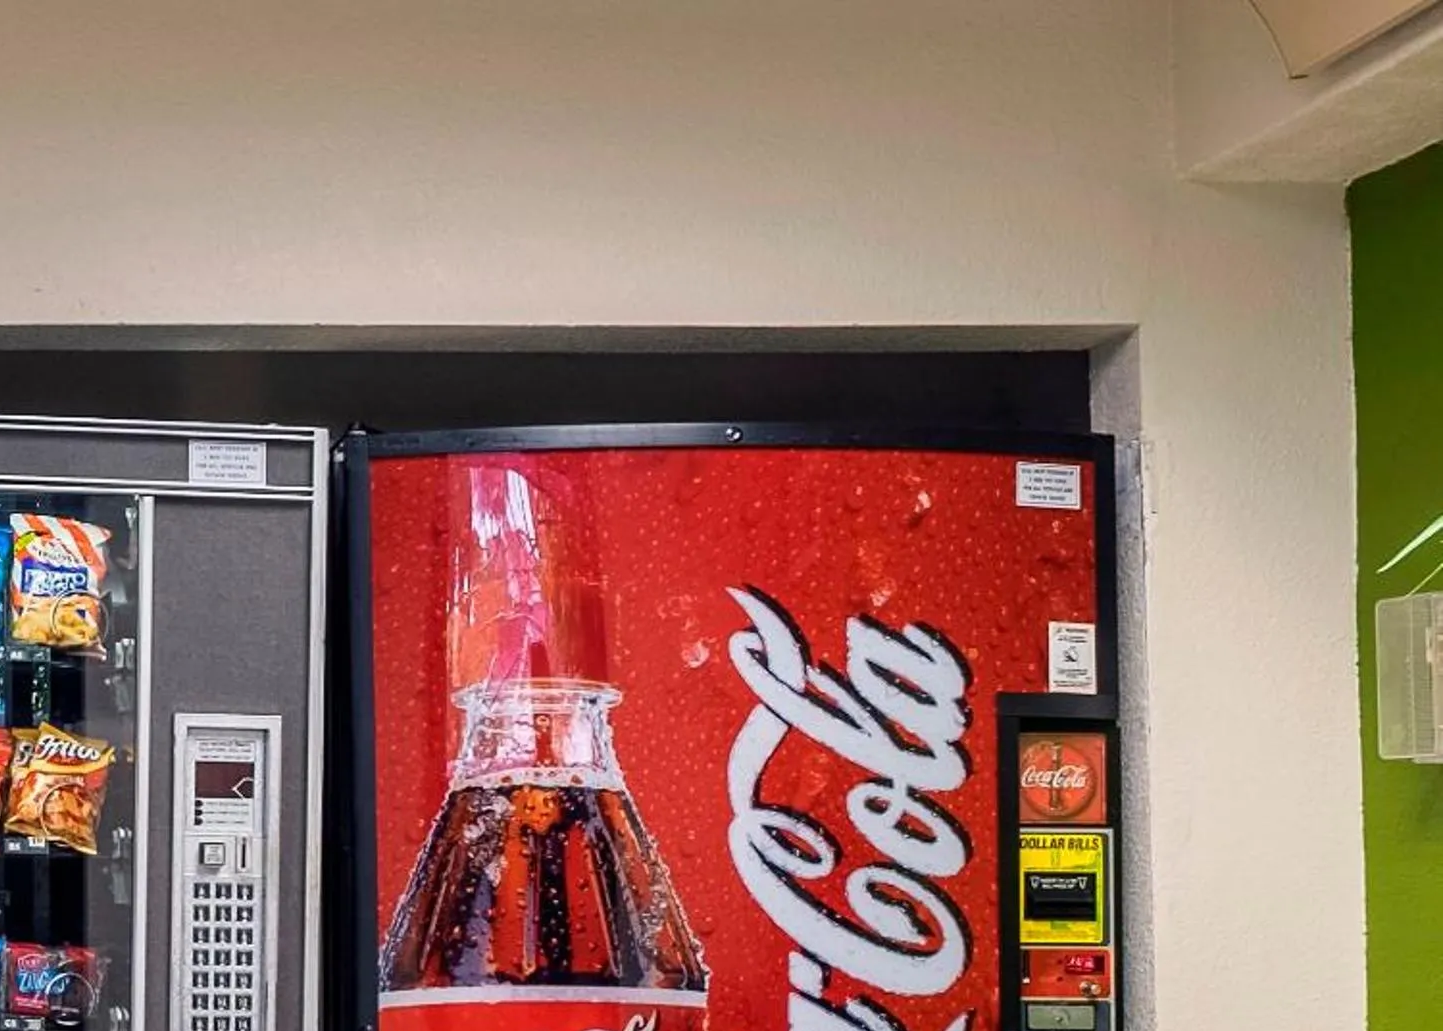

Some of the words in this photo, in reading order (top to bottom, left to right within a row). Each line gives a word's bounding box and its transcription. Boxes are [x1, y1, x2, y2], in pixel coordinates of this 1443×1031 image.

[1021, 764, 1088, 788] Coca-Cola
[1019, 837, 1065, 849] DOLLAR
[1067, 838, 1099, 850] BILLS
